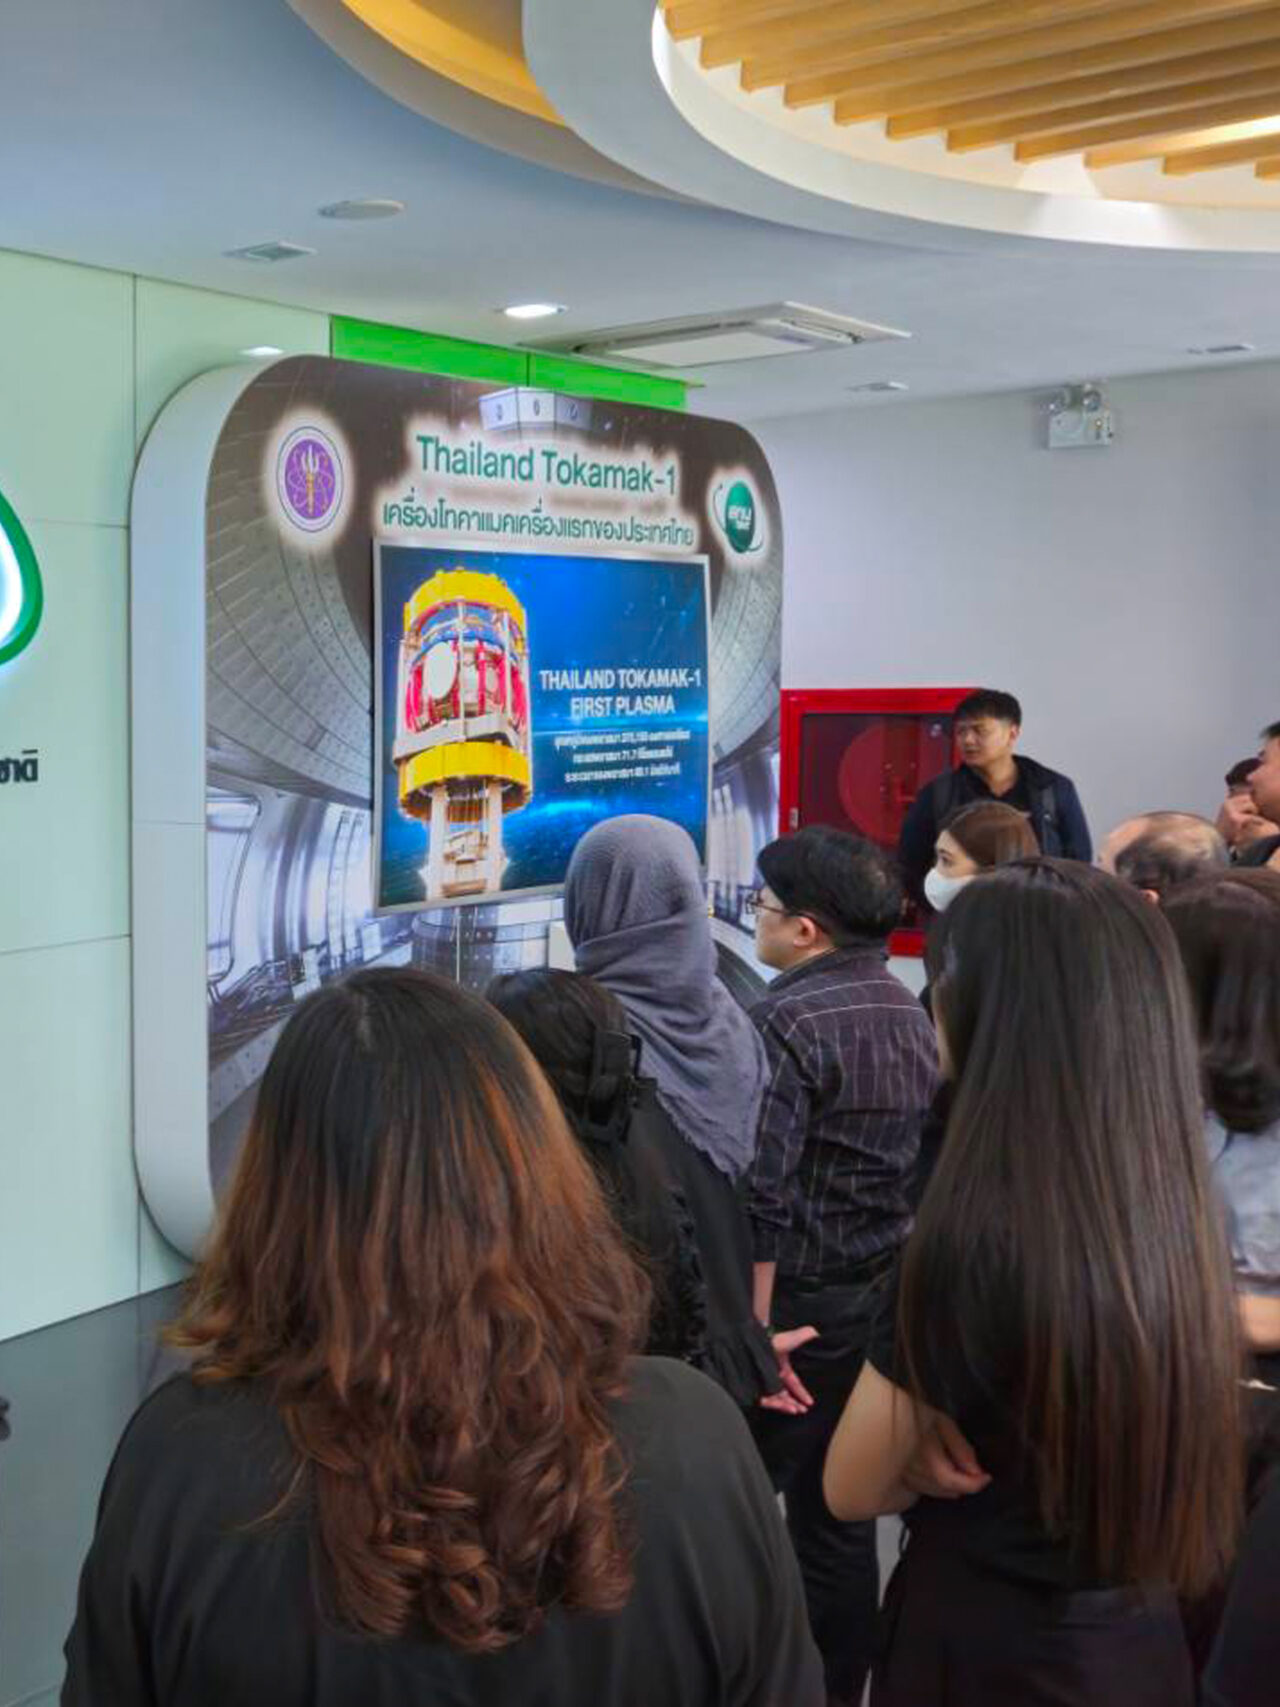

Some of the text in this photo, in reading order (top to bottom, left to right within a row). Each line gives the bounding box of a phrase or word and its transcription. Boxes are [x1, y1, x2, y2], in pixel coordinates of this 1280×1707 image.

[416, 435, 676, 495] Thailand Tokamak-1
[539, 668, 702, 690] THAILAND TOKAMAK-1
[571, 695, 676, 718] FIRST PLASMA
